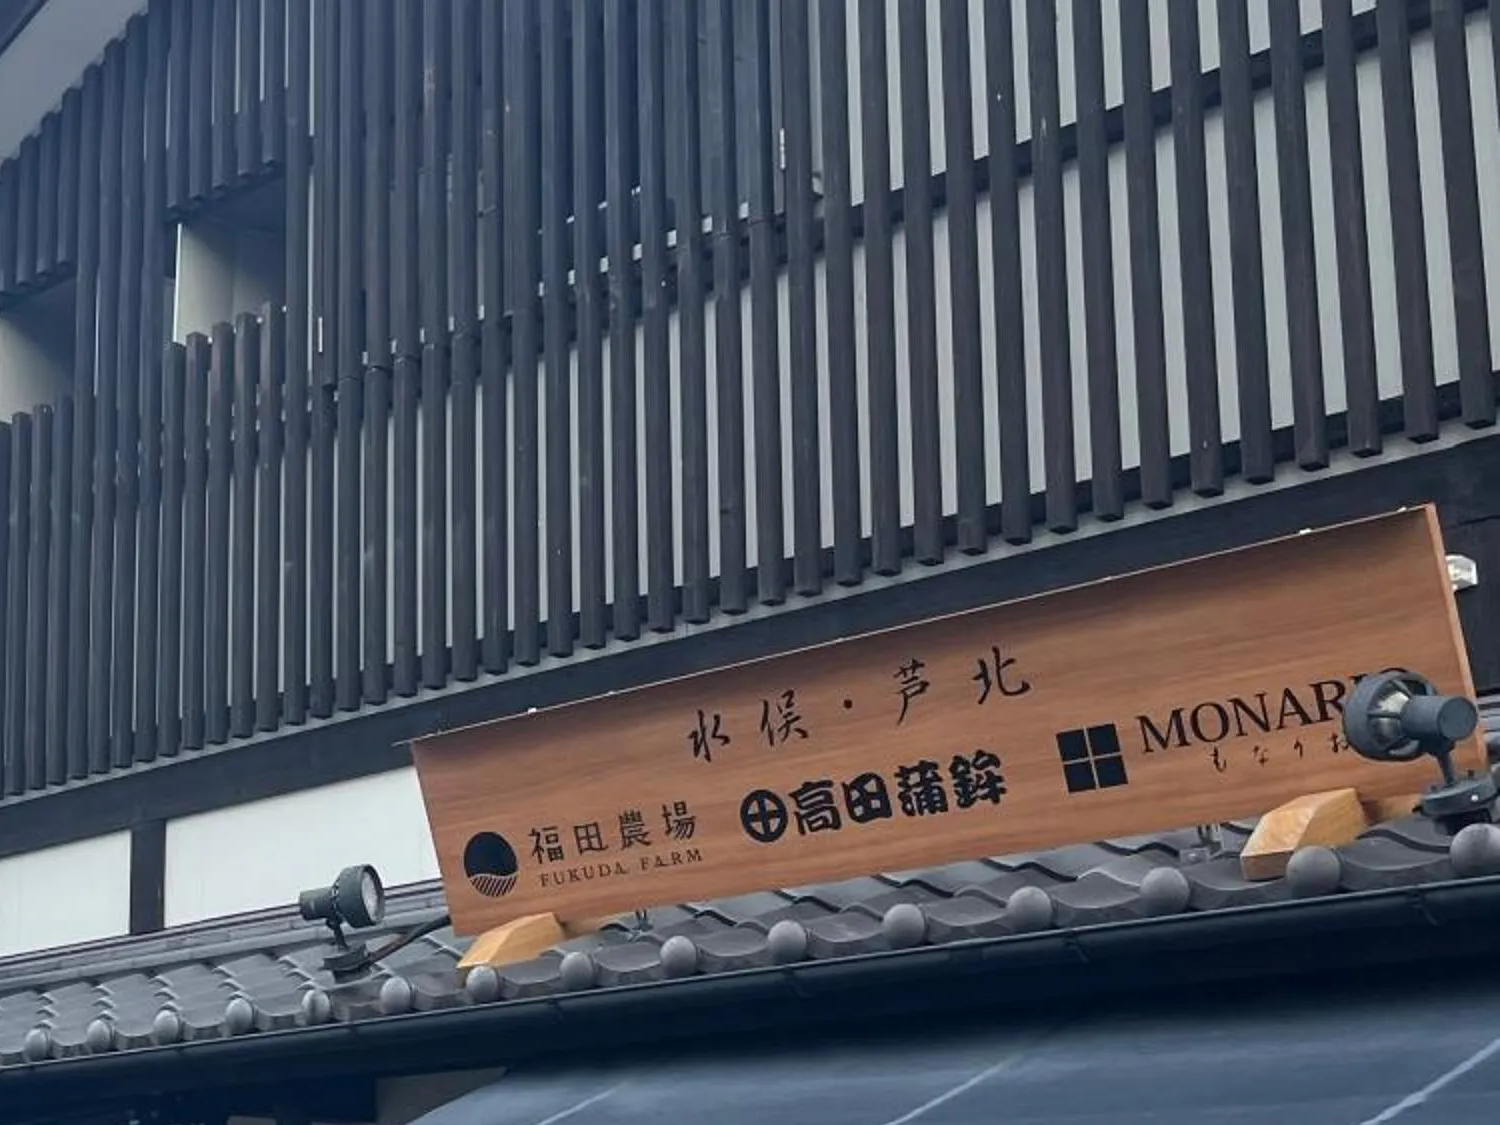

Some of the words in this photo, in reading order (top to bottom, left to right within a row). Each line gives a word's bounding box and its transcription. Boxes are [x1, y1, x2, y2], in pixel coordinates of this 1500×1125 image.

[1135, 667, 1412, 753] MONAR
[529, 801, 696, 864] 福田農場
[540, 860, 627, 887] FUKUDA
[640, 849, 703, 873] FARM
